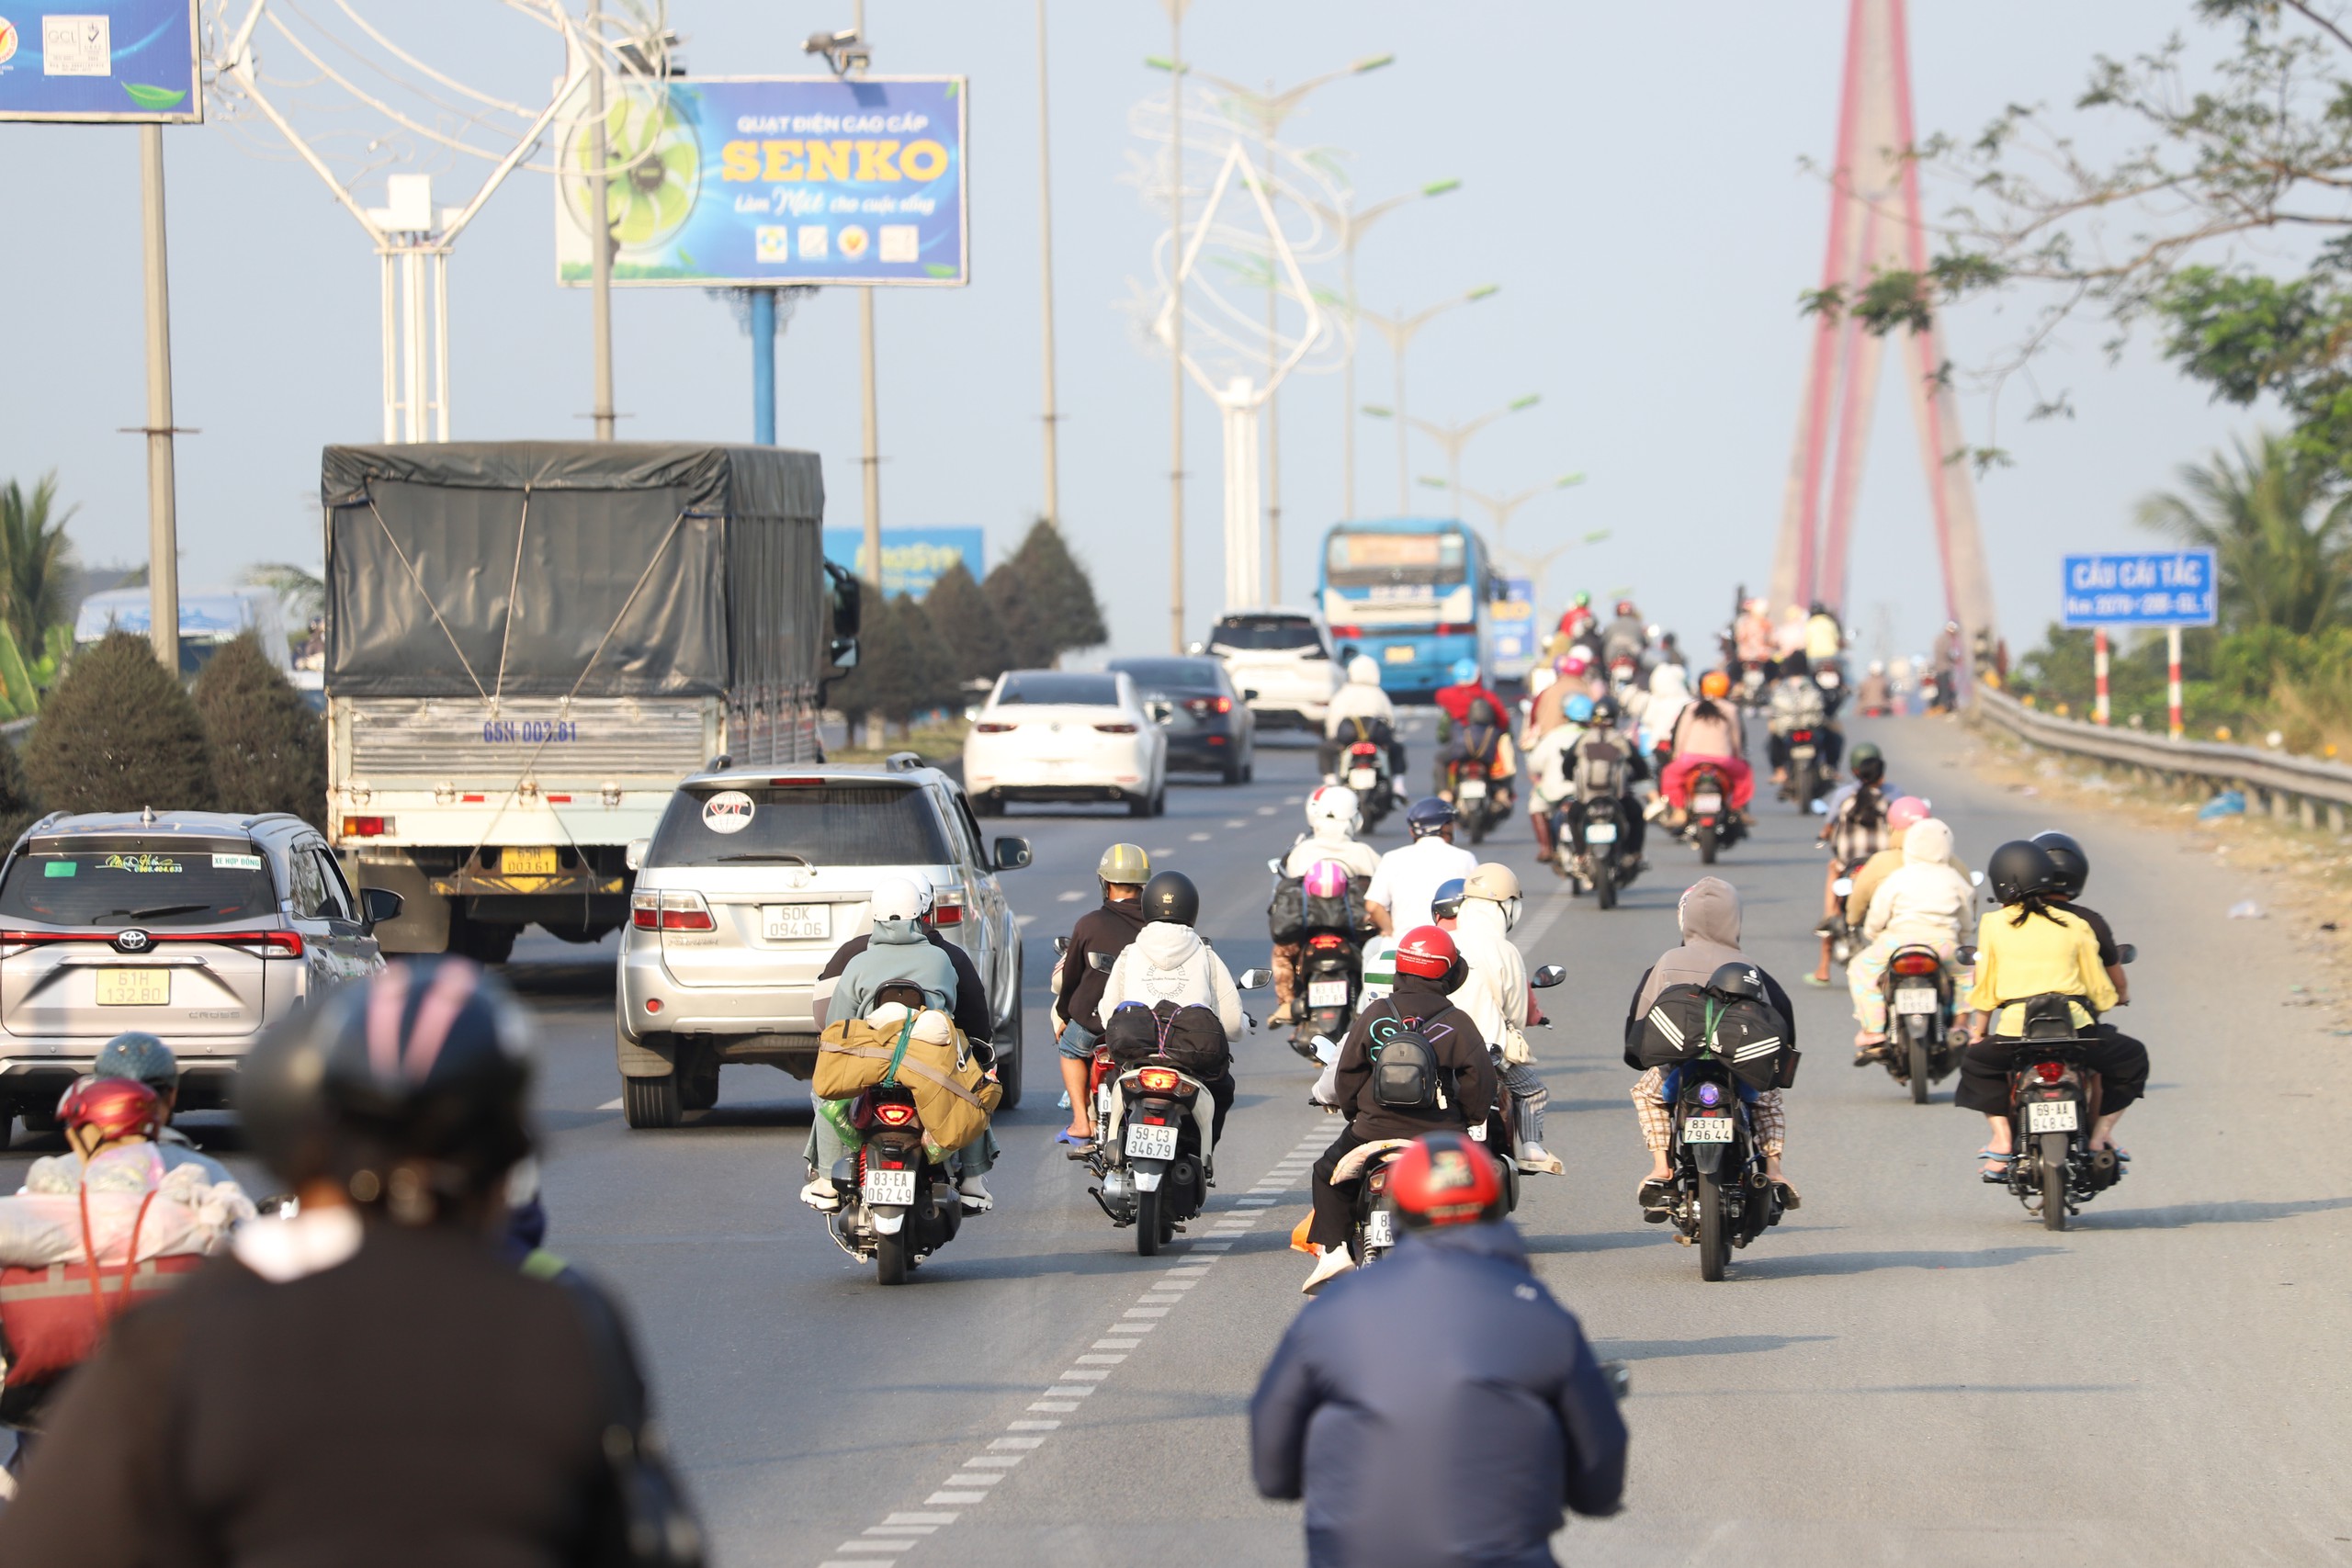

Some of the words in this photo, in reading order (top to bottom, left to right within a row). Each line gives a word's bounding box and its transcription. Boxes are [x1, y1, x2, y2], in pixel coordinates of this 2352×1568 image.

[842, 115, 885, 133] CAO
[721, 139, 948, 182] SENKO
[782, 907, 810, 920] 60K
[770, 922, 822, 937] 094.06
[119, 972, 149, 986] 61H
[107, 987, 161, 1002] 132.80
[1692, 1119, 1725, 1129] 83-C1
[1136, 1126, 1170, 1143] 59-C3
[1687, 1130, 1730, 1140] 796.44
[1130, 1141, 1171, 1157] 346.79
[874, 1171, 908, 1187] 83-EA
[868, 1188, 912, 1203] 062.49
